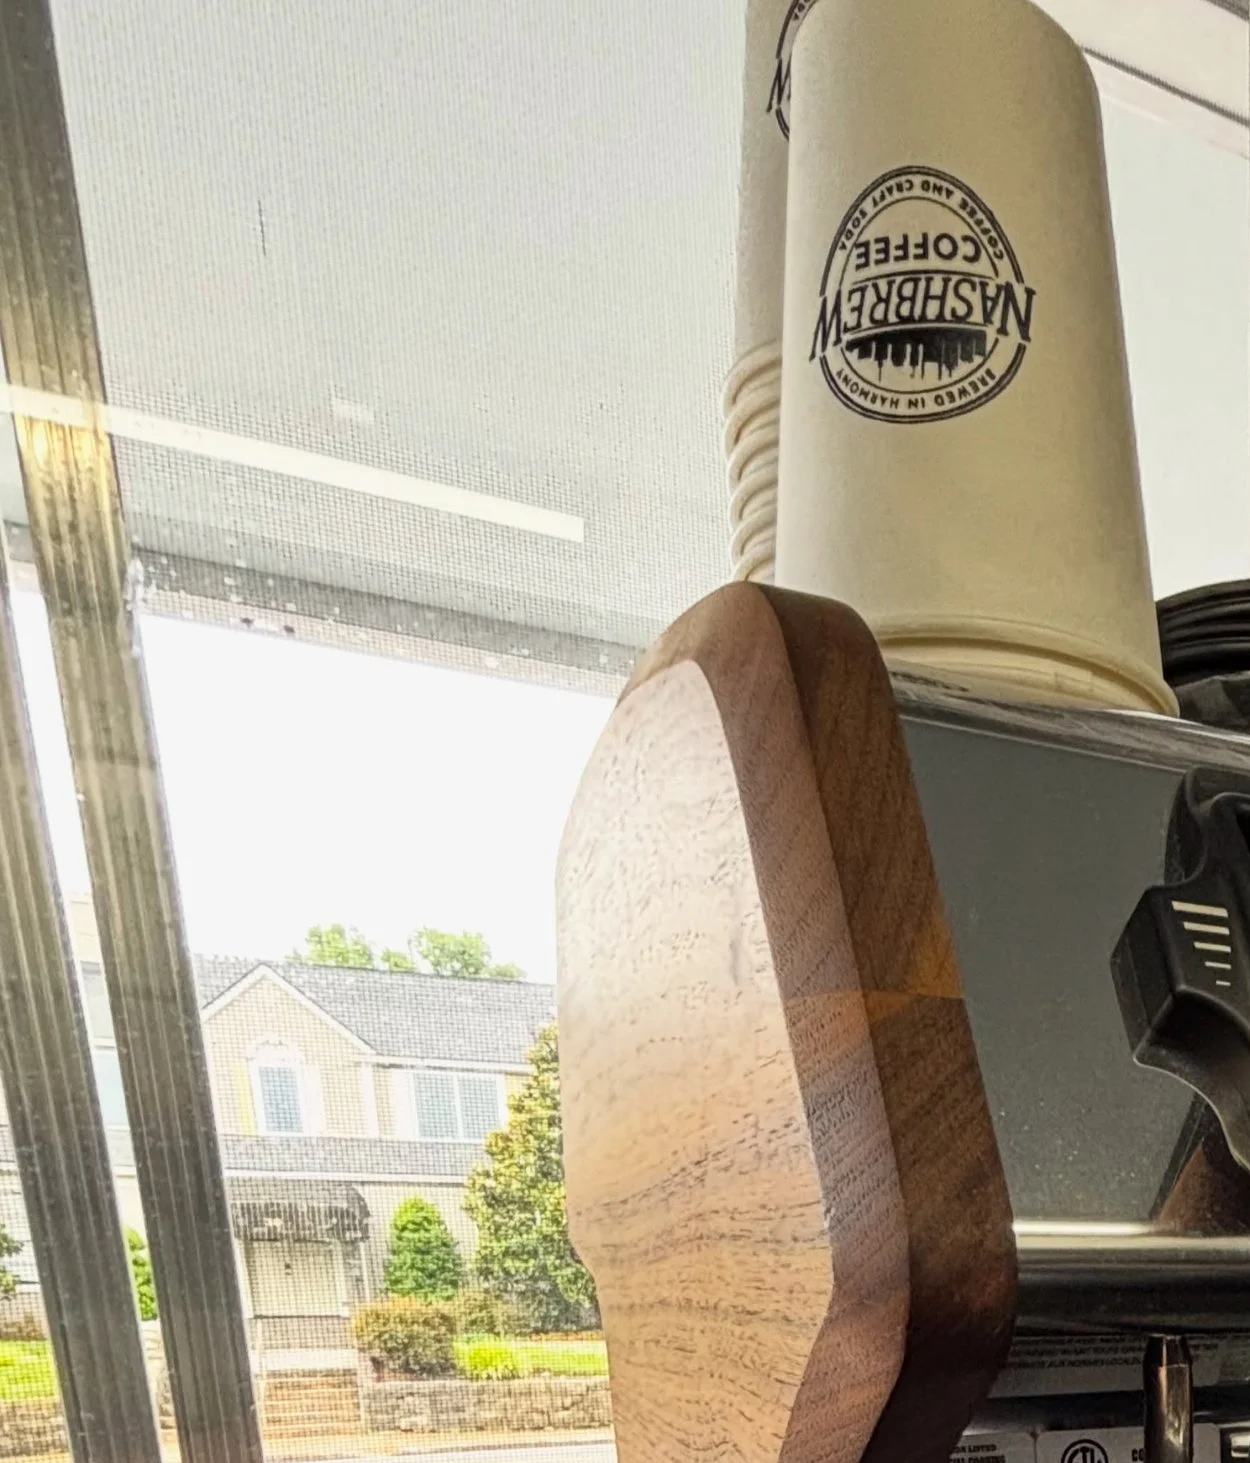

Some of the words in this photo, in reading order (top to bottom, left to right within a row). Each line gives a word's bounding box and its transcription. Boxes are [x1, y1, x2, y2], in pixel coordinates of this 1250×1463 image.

[872, 178, 914, 209] CRAFT
[921, 179, 954, 200] AND
[839, 209, 868, 251] SODA
[959, 197, 1004, 261] COFFEE
[853, 232, 982, 271] COFFEE
[809, 276, 1037, 363] NASHBREW
[836, 367, 899, 410] HARMONY
[907, 399, 926, 410] IN
[934, 367, 997, 407] BREWED
